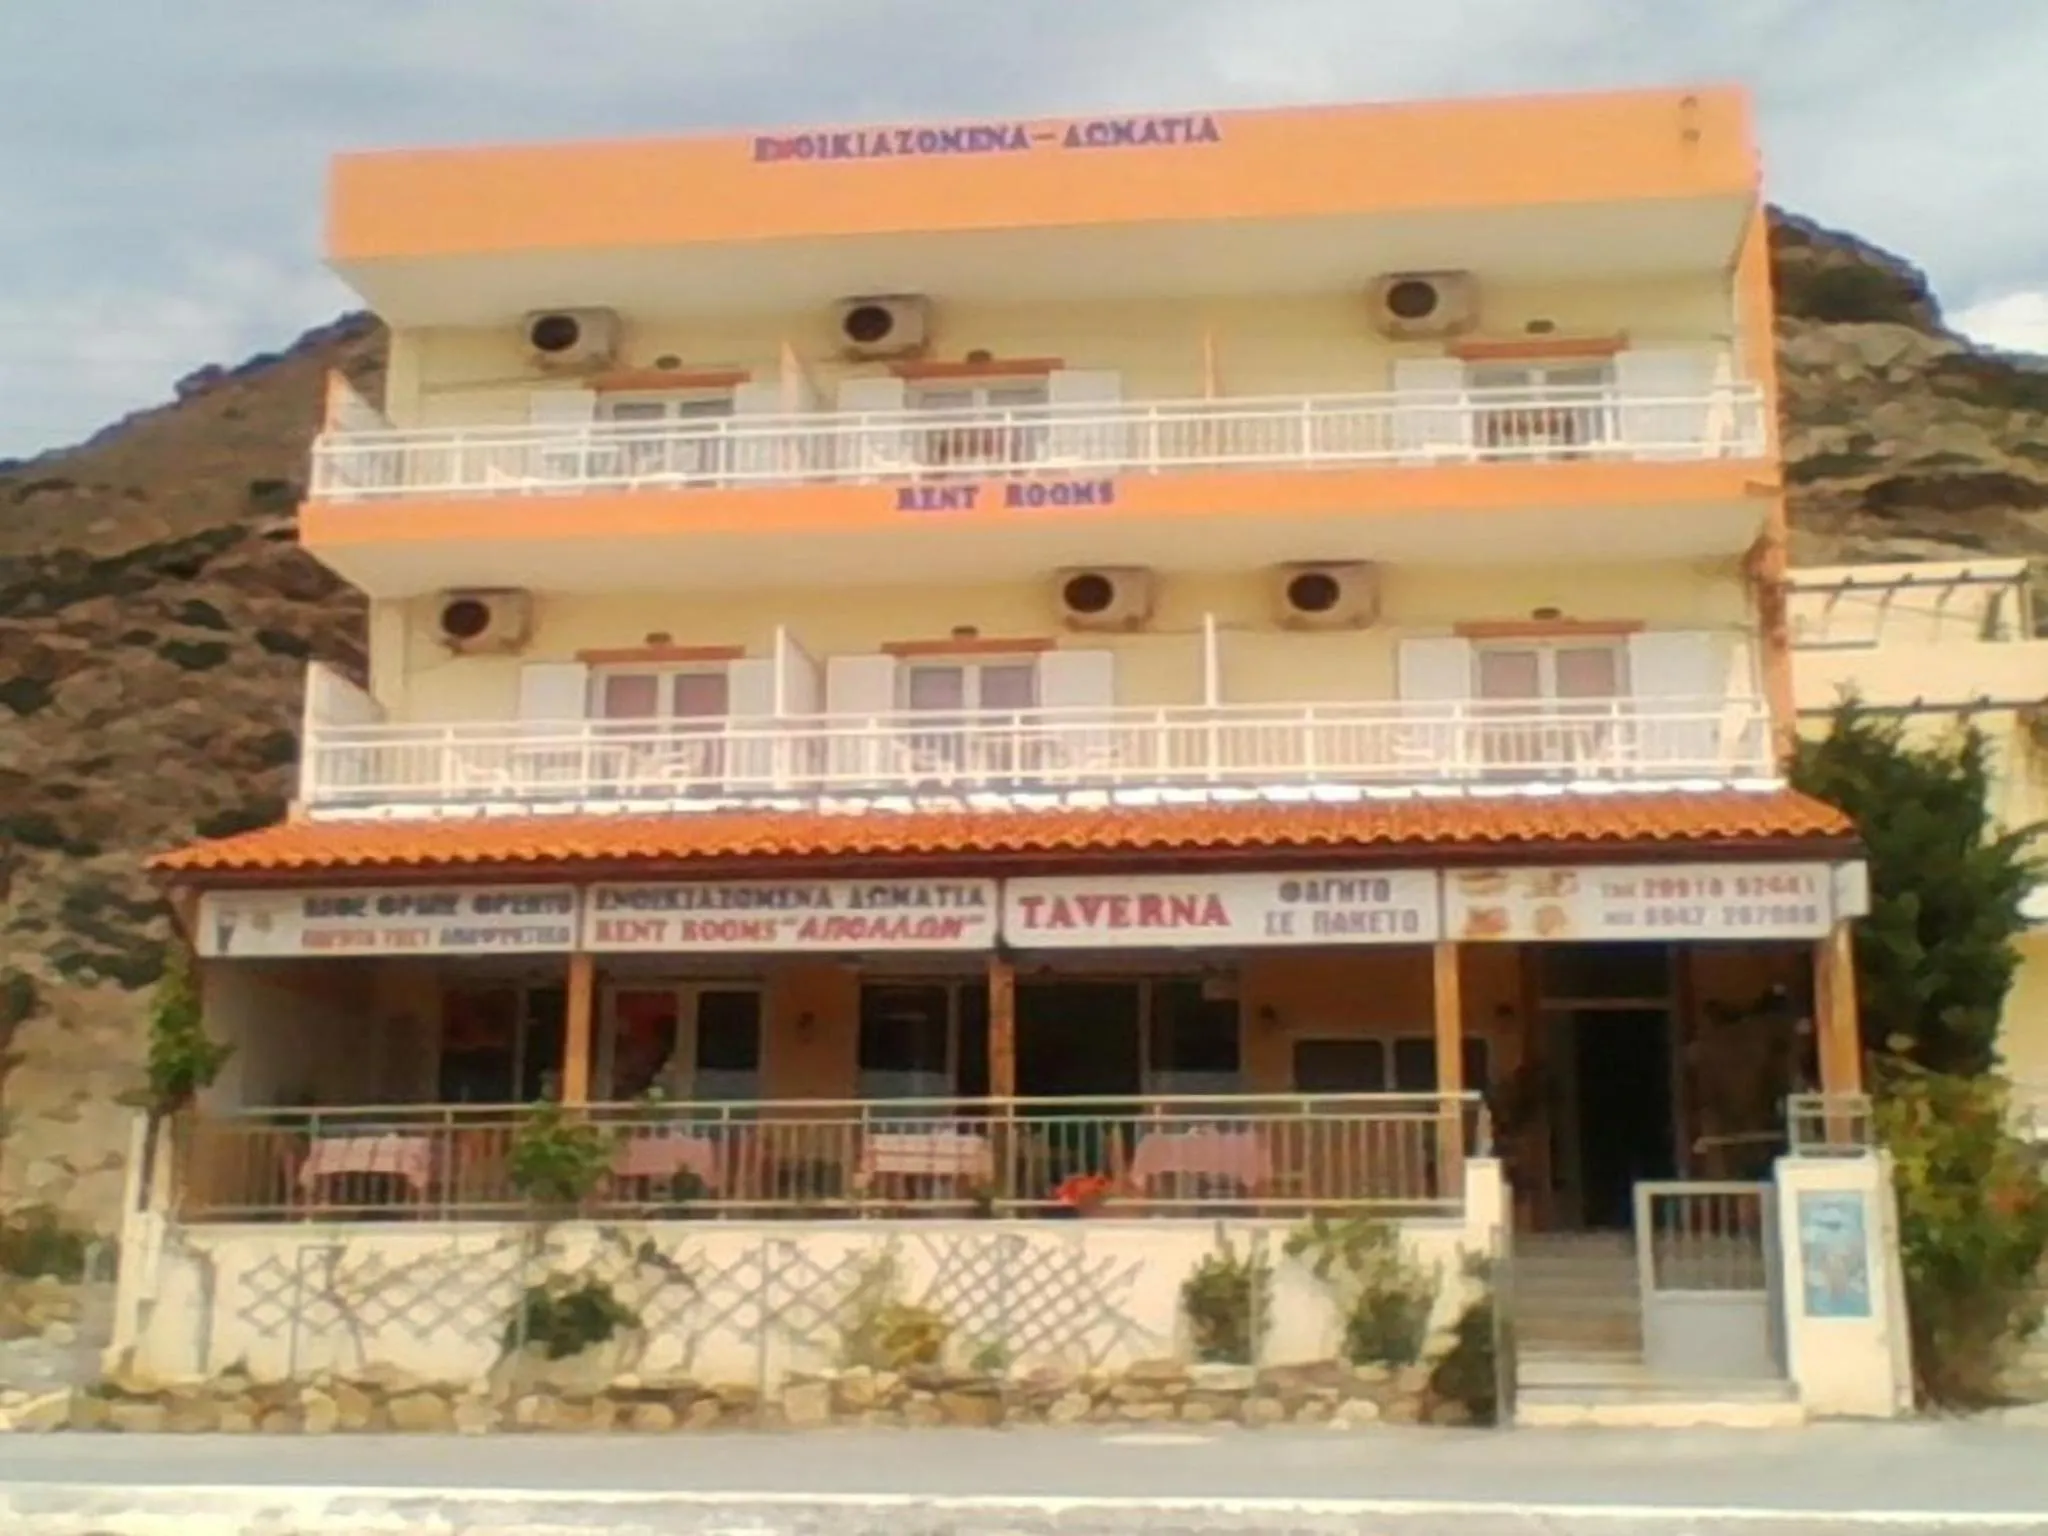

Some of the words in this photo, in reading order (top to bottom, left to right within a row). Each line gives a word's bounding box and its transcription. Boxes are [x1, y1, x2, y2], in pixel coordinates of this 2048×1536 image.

[896, 484, 979, 511] RENT
[1005, 479, 1115, 508] ROOMS
[1279, 878, 1392, 904] ΦΑΓΗΤΟ
[1018, 892, 1232, 930] TAVERNA
[1313, 908, 1419, 935] ΠΑΚΕΤΟ
[595, 918, 669, 943] RENT
[682, 917, 778, 942] ROOMS
